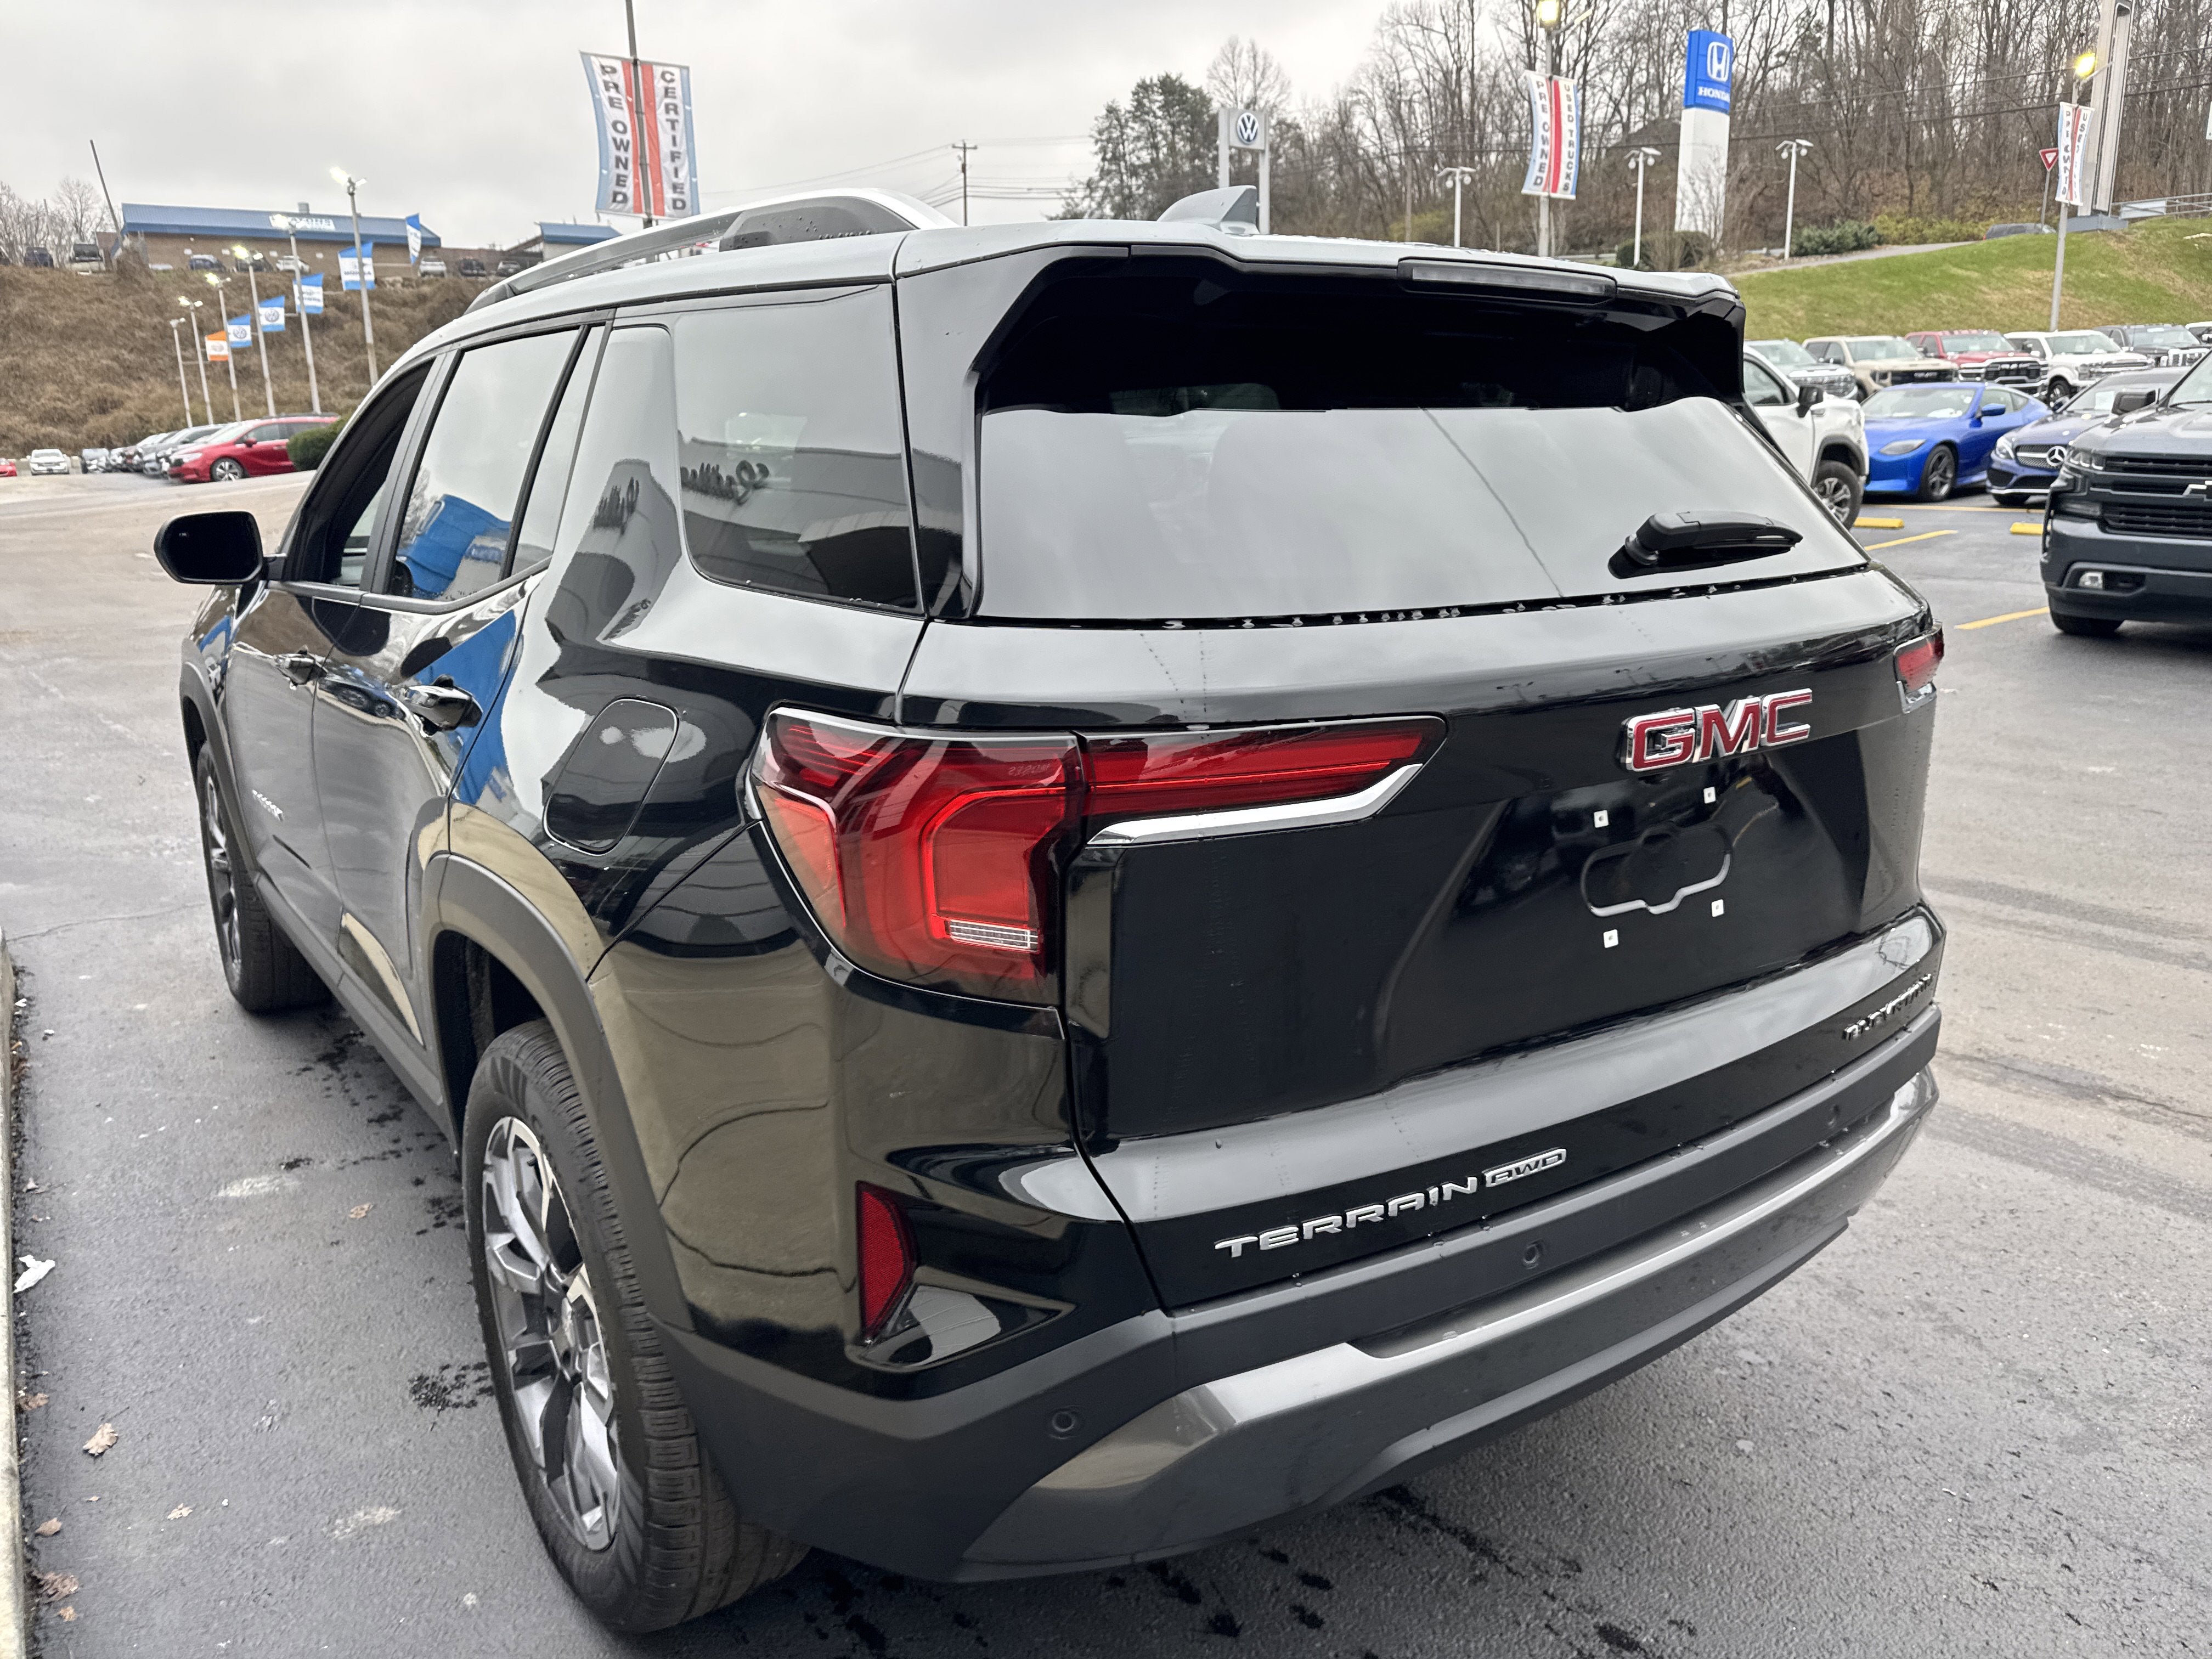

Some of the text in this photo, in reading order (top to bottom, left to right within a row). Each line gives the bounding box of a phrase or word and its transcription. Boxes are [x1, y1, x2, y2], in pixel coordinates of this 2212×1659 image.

[600, 64, 630, 204] PRE OWNED
[661, 70, 686, 210] CERTIFIED
[1533, 81, 1550, 186] PRE OWNED
[1564, 84, 1575, 191] USED TRUCKS
[1623, 688, 1812, 772] GMC
[1215, 1149, 1565, 1257] TERRAIN AWD
